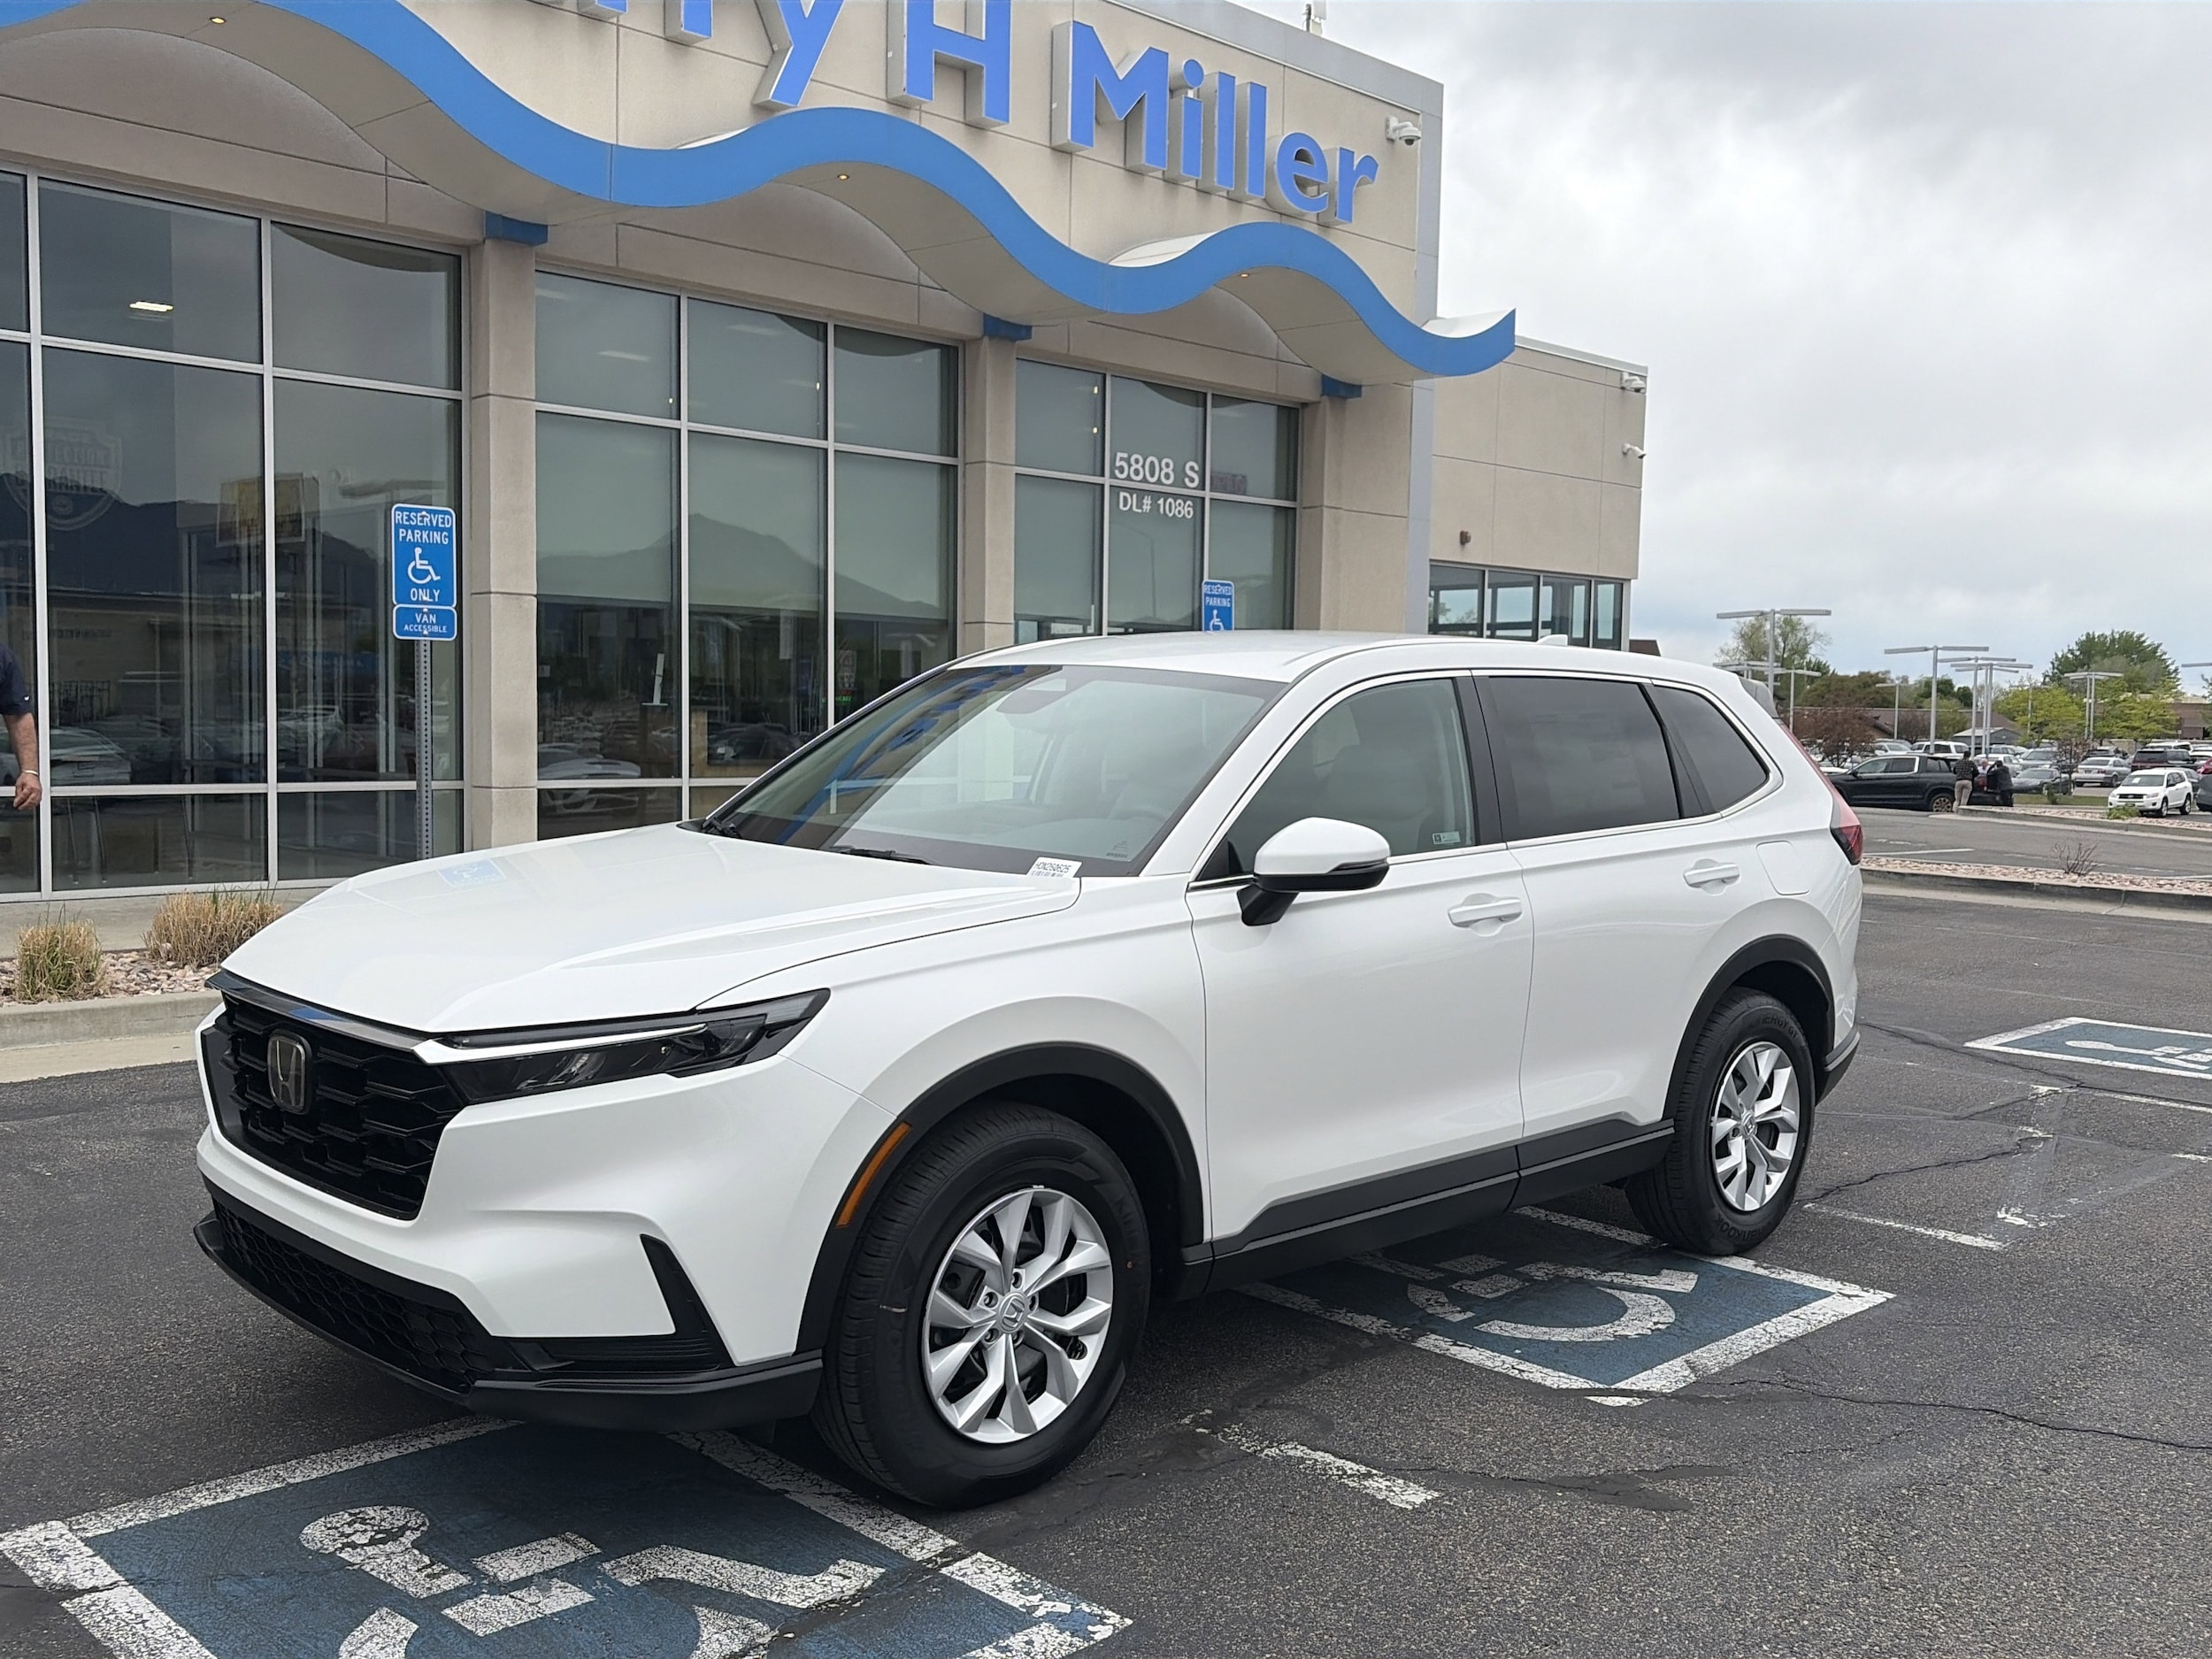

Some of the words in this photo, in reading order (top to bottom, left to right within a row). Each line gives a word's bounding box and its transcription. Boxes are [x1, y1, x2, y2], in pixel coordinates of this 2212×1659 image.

[901, 0, 1011, 127] H
[1060, 19, 1379, 226] Miller
[1114, 451, 1175, 485] 5808
[1184, 460, 1200, 488] S
[1118, 491, 1152, 513] DL#
[1157, 497, 1194, 518] 1086
[395, 511, 451, 527] RESERVED
[398, 528, 449, 545] PARKING
[410, 588, 441, 603] ONLY
[1203, 584, 1233, 595] RESERVED
[1205, 596, 1231, 608] PARKING
[415, 612, 437, 624] VAN
[403, 623, 448, 634] ACCESSIBLE
